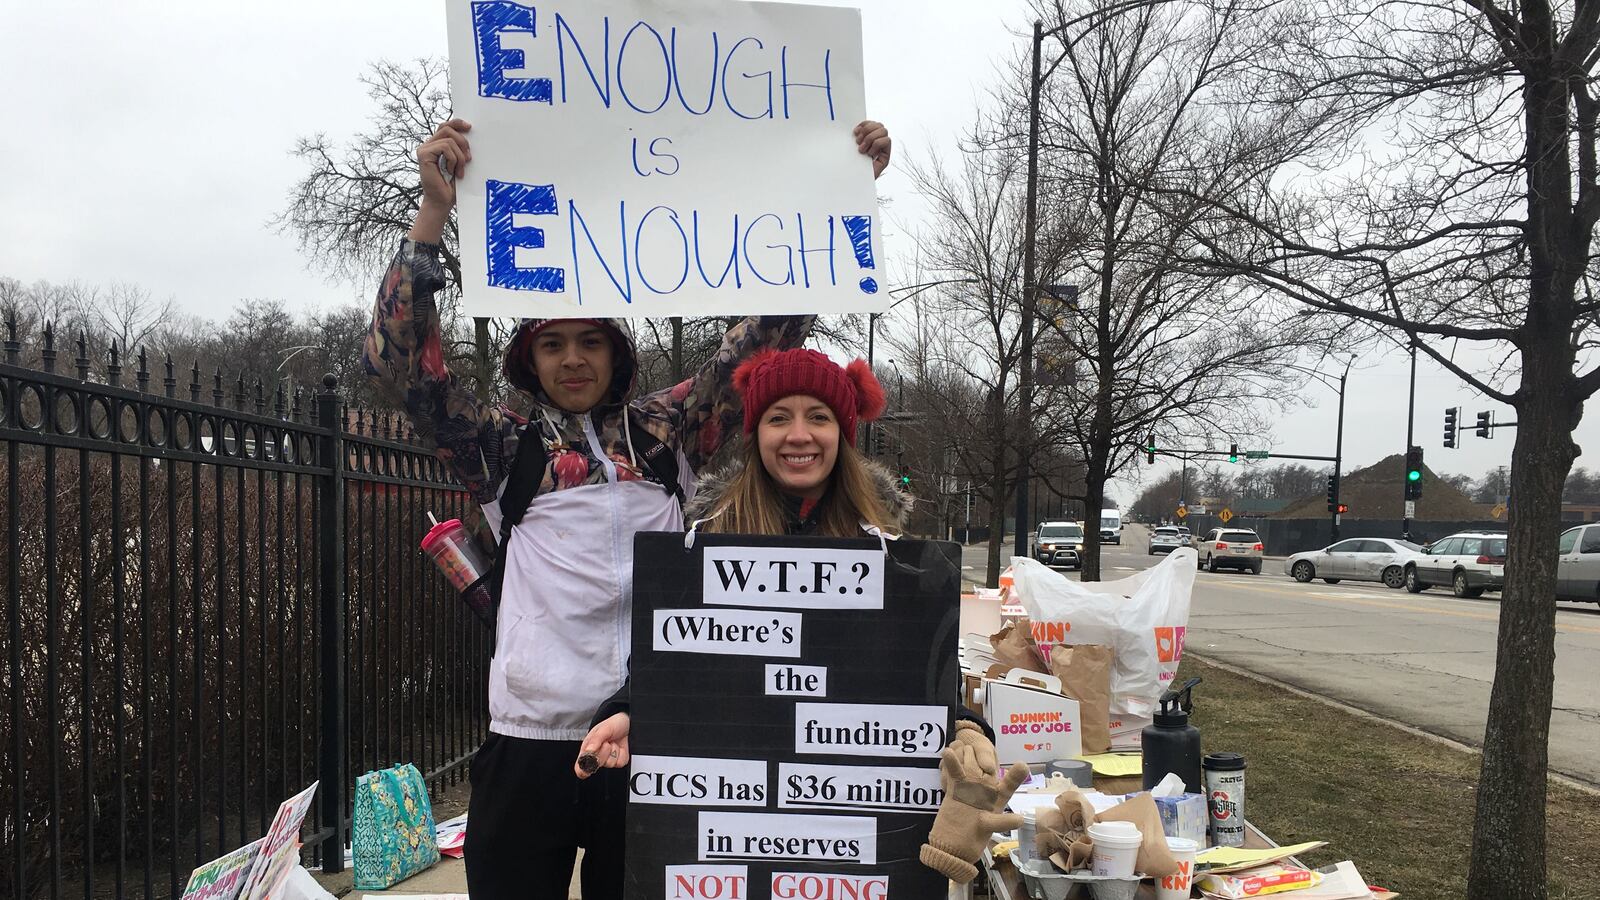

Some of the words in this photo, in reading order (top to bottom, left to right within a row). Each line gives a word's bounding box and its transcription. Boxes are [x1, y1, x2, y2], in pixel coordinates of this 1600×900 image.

[471, 1, 835, 120] ENOUGH
[486, 179, 879, 305] ENOUGH!
[712, 559, 870, 595] W.T.F.?
[662, 615, 794, 645] (Where's
[773, 667, 819, 692] the
[1001, 724, 1027, 734] BOX
[1046, 722, 1072, 733] JOE
[1010, 712, 1063, 723] DUNKIN'
[804, 720, 946, 754] funding?)
[630, 771, 708, 798] CICS
[718, 776, 765, 802] has
[787, 774, 837, 802] $36
[847, 778, 945, 806] million
[707, 829, 732, 854] in
[744, 834, 860, 857] reserves
[674, 875, 745, 899] NOT
[773, 874, 886, 900] GOING
